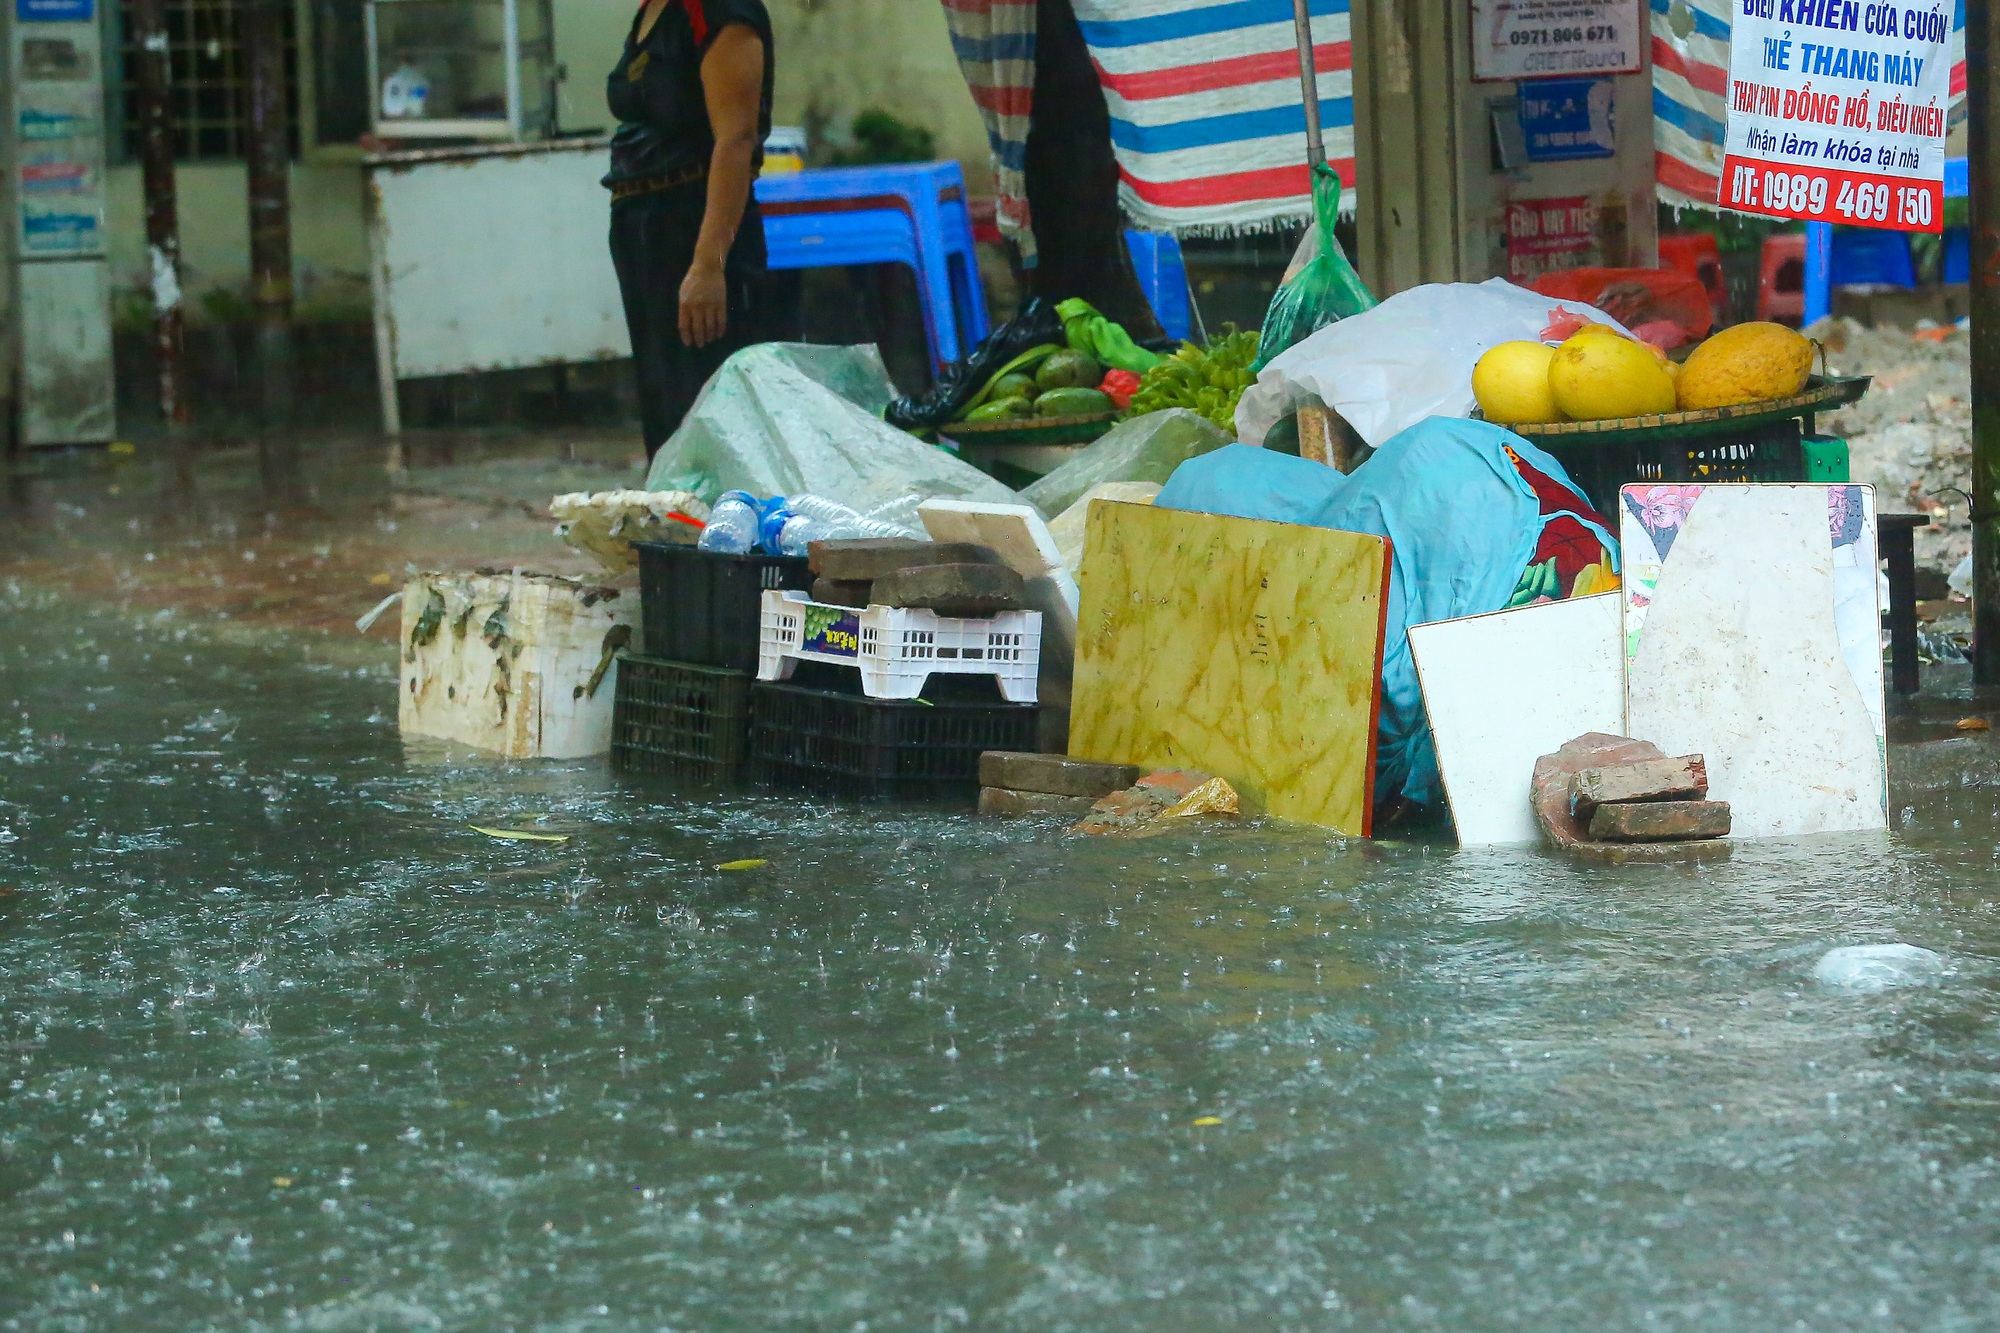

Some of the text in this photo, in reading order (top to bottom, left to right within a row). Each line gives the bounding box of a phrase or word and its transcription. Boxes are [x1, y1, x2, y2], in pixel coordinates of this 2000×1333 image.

[1510, 25, 1613, 45] 0971 806 671
[1902, 3, 1949, 44] CUỐN
[1763, 30, 1924, 87] THẺ THANG MÁY
[1733, 81, 1944, 138] THAY PIN ĐỒNG HỒ, ĐIỀU KHIỂN
[1746, 127, 1920, 171] Nhận làm khóa tại nhà
[1731, 164, 1933, 226] ĐT: 0989 469 150
